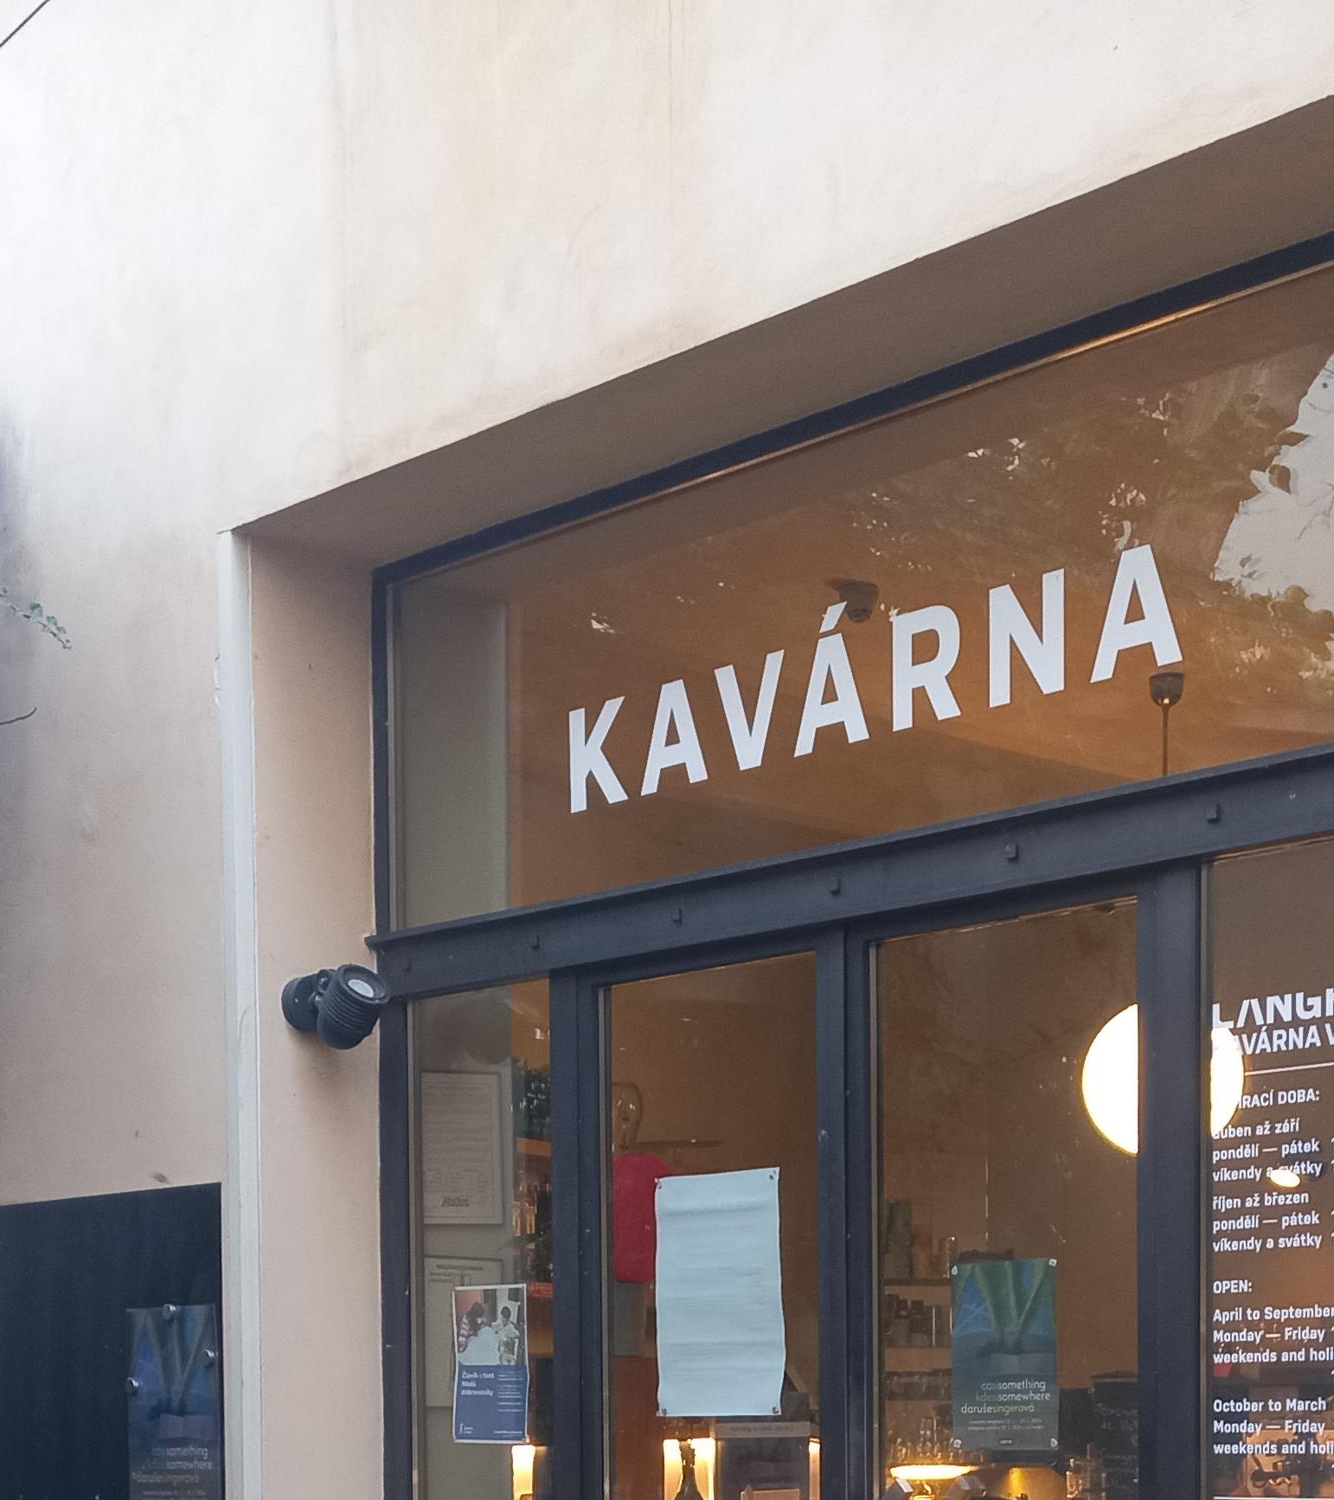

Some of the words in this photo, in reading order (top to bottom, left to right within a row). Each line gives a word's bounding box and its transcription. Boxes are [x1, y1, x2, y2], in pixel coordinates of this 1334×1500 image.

[569, 544, 1183, 813] KAVÁRNA
[1229, 1024, 1322, 1056] VÁRNA
[1277, 1087, 1320, 1105] DOBA:
[1255, 1120, 1272, 1136] až
[1274, 1117, 1300, 1135] září
[1212, 1143, 1259, 1164] pondělí
[1281, 1138, 1320, 1159] pátek
[1212, 1165, 1262, 1183] víkendy
[1212, 1194, 1241, 1212] říjen
[1245, 1192, 1261, 1208] až
[1264, 1191, 1309, 1207] březen
[1212, 1214, 1259, 1235] pondělí
[1281, 1209, 1320, 1229] pátek
[1212, 1235, 1262, 1253] víkendy
[1265, 1237, 1275, 1249] a
[1278, 1231, 1323, 1249] svátky
[1213, 1279, 1253, 1295] OPEN:
[1212, 1306, 1243, 1324] April
[1246, 1307, 1261, 1321] to
[1212, 1327, 1263, 1345] Monday
[1284, 1326, 1326, 1343] Friday
[1212, 1347, 1277, 1364] weekends
[1281, 1347, 1306, 1362] and
[1213, 1397, 1265, 1413] October
[1268, 1398, 1282, 1412] to
[1285, 1396, 1327, 1412] March
[1213, 1419, 1263, 1436] Monday
[1284, 1419, 1326, 1436] Friday
[1213, 1440, 1278, 1455] weekends
[1281, 1439, 1306, 1454] and
